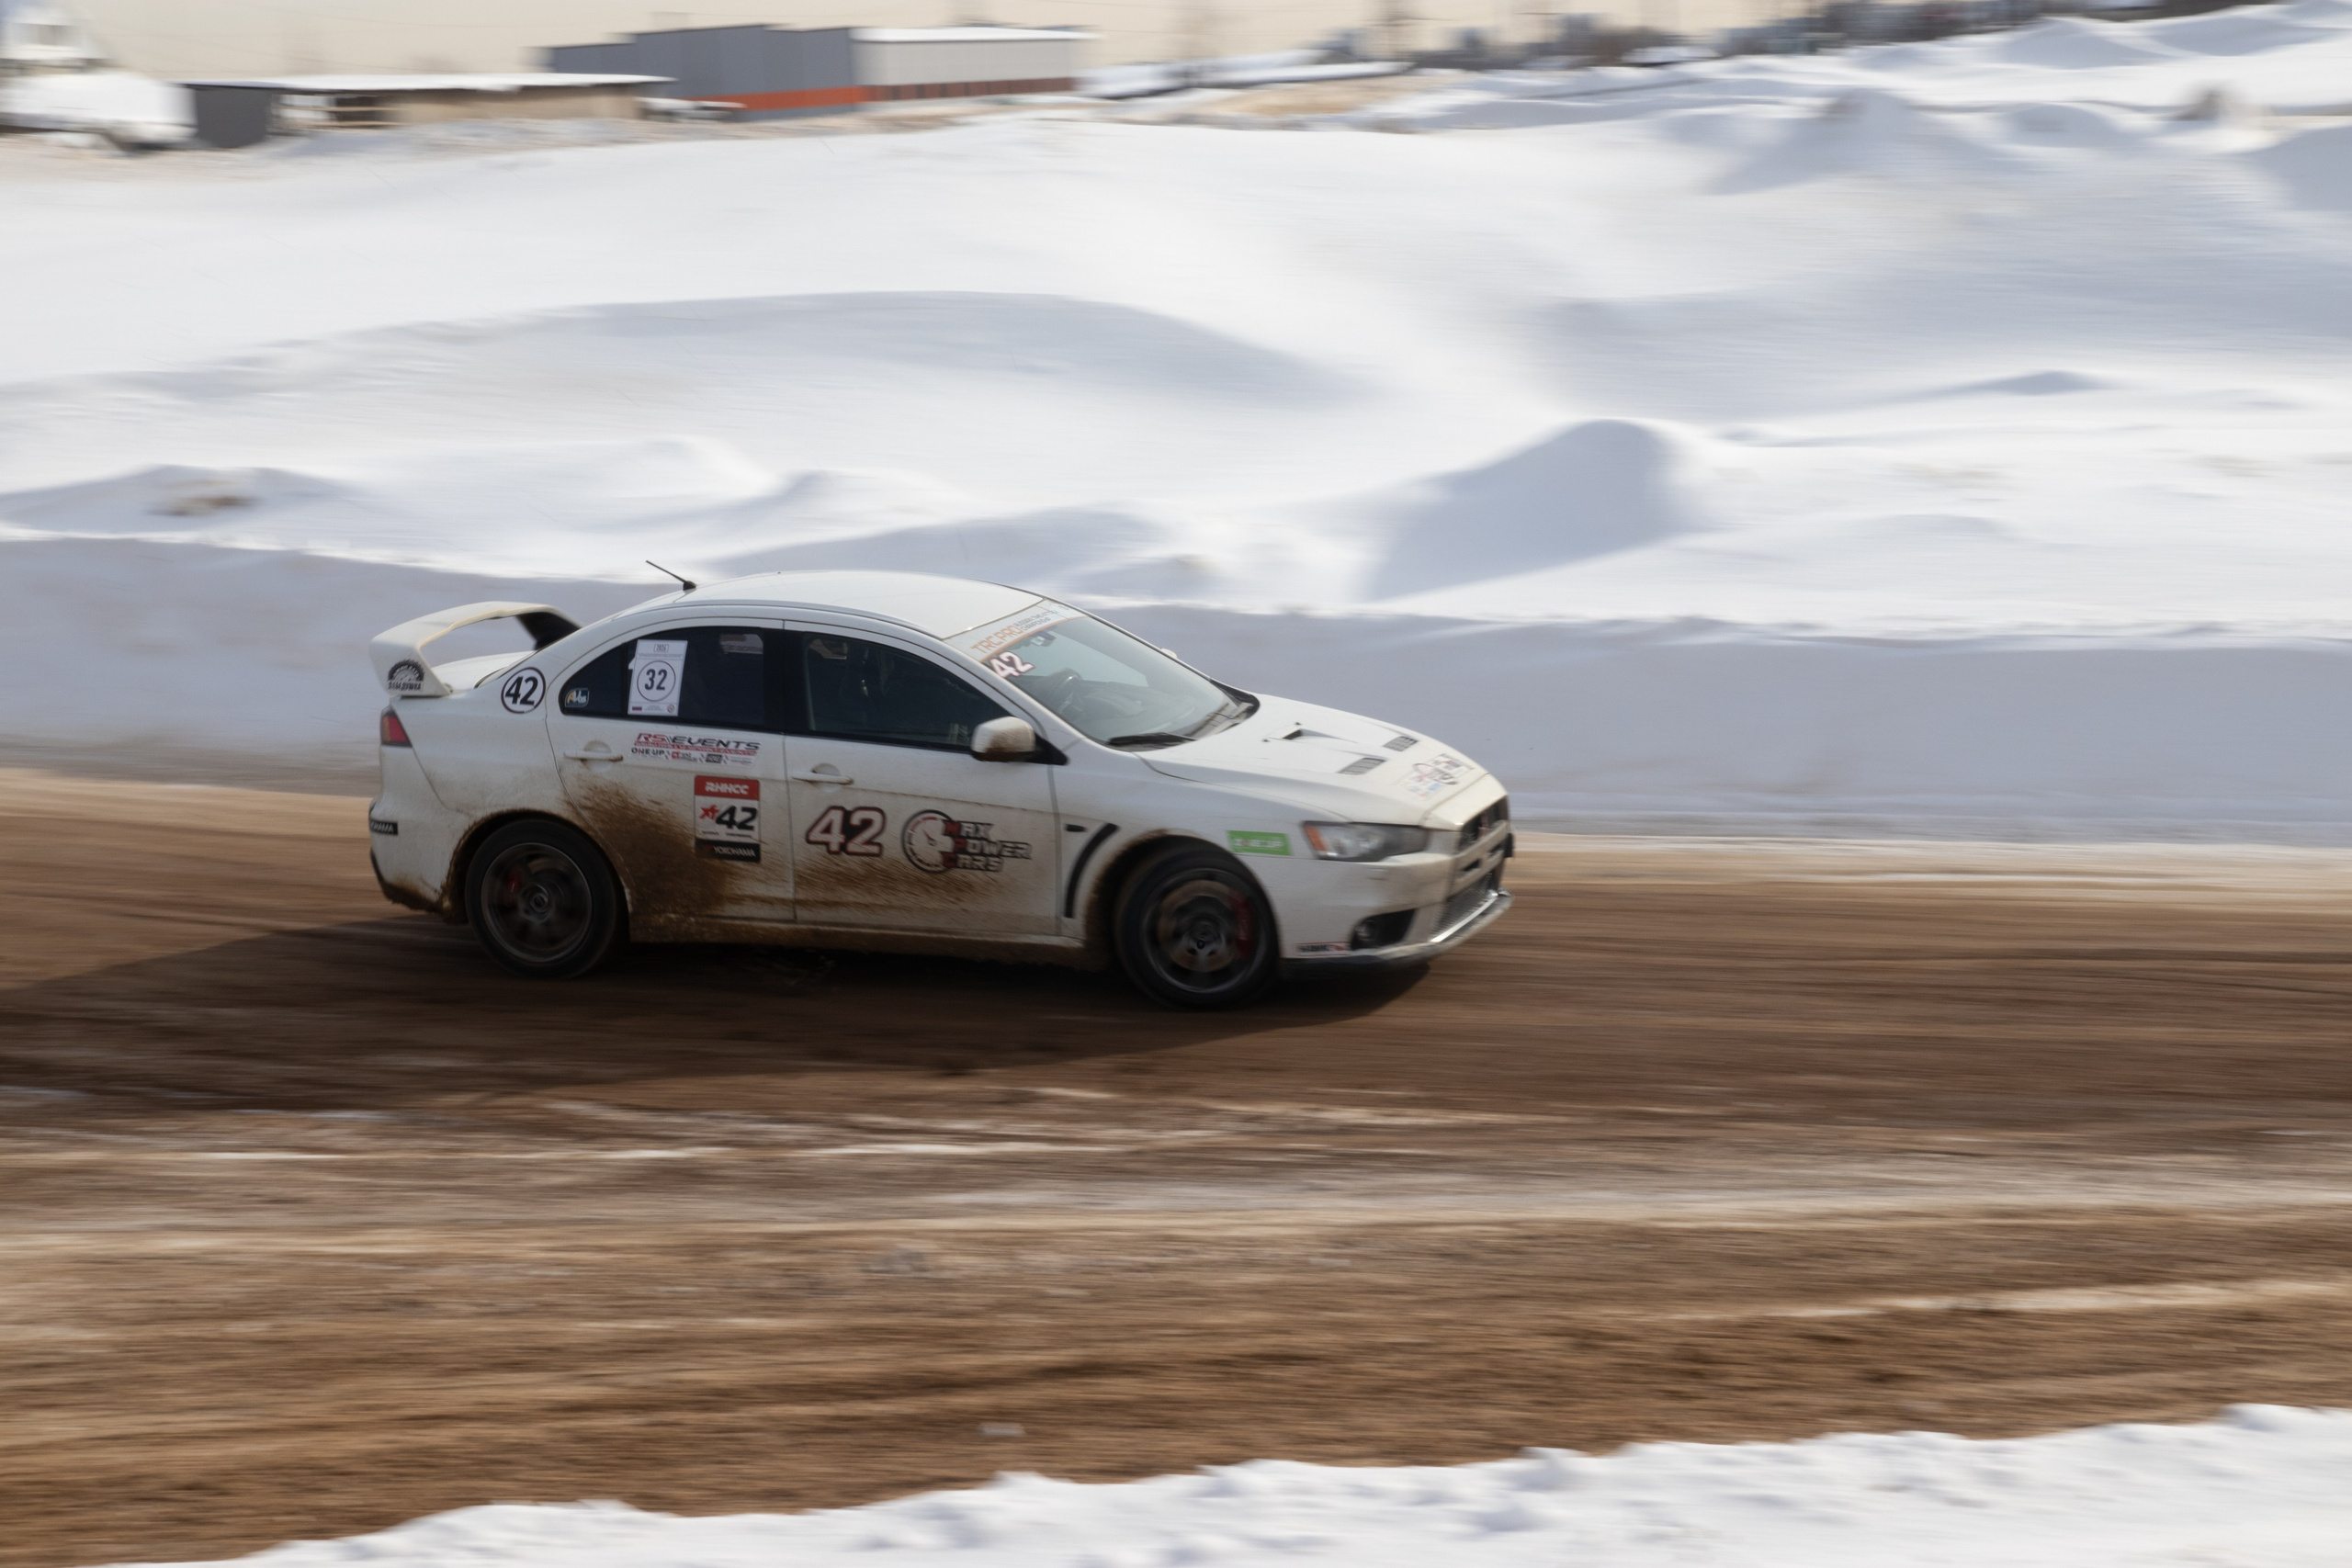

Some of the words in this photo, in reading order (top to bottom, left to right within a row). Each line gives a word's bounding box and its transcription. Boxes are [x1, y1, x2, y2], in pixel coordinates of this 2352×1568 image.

[989, 650, 1035, 679] 42
[505, 676, 538, 705] 42
[644, 668, 668, 691] 32
[672, 735, 761, 750] EVENTS
[715, 805, 758, 831] 42
[806, 806, 887, 857] 42
